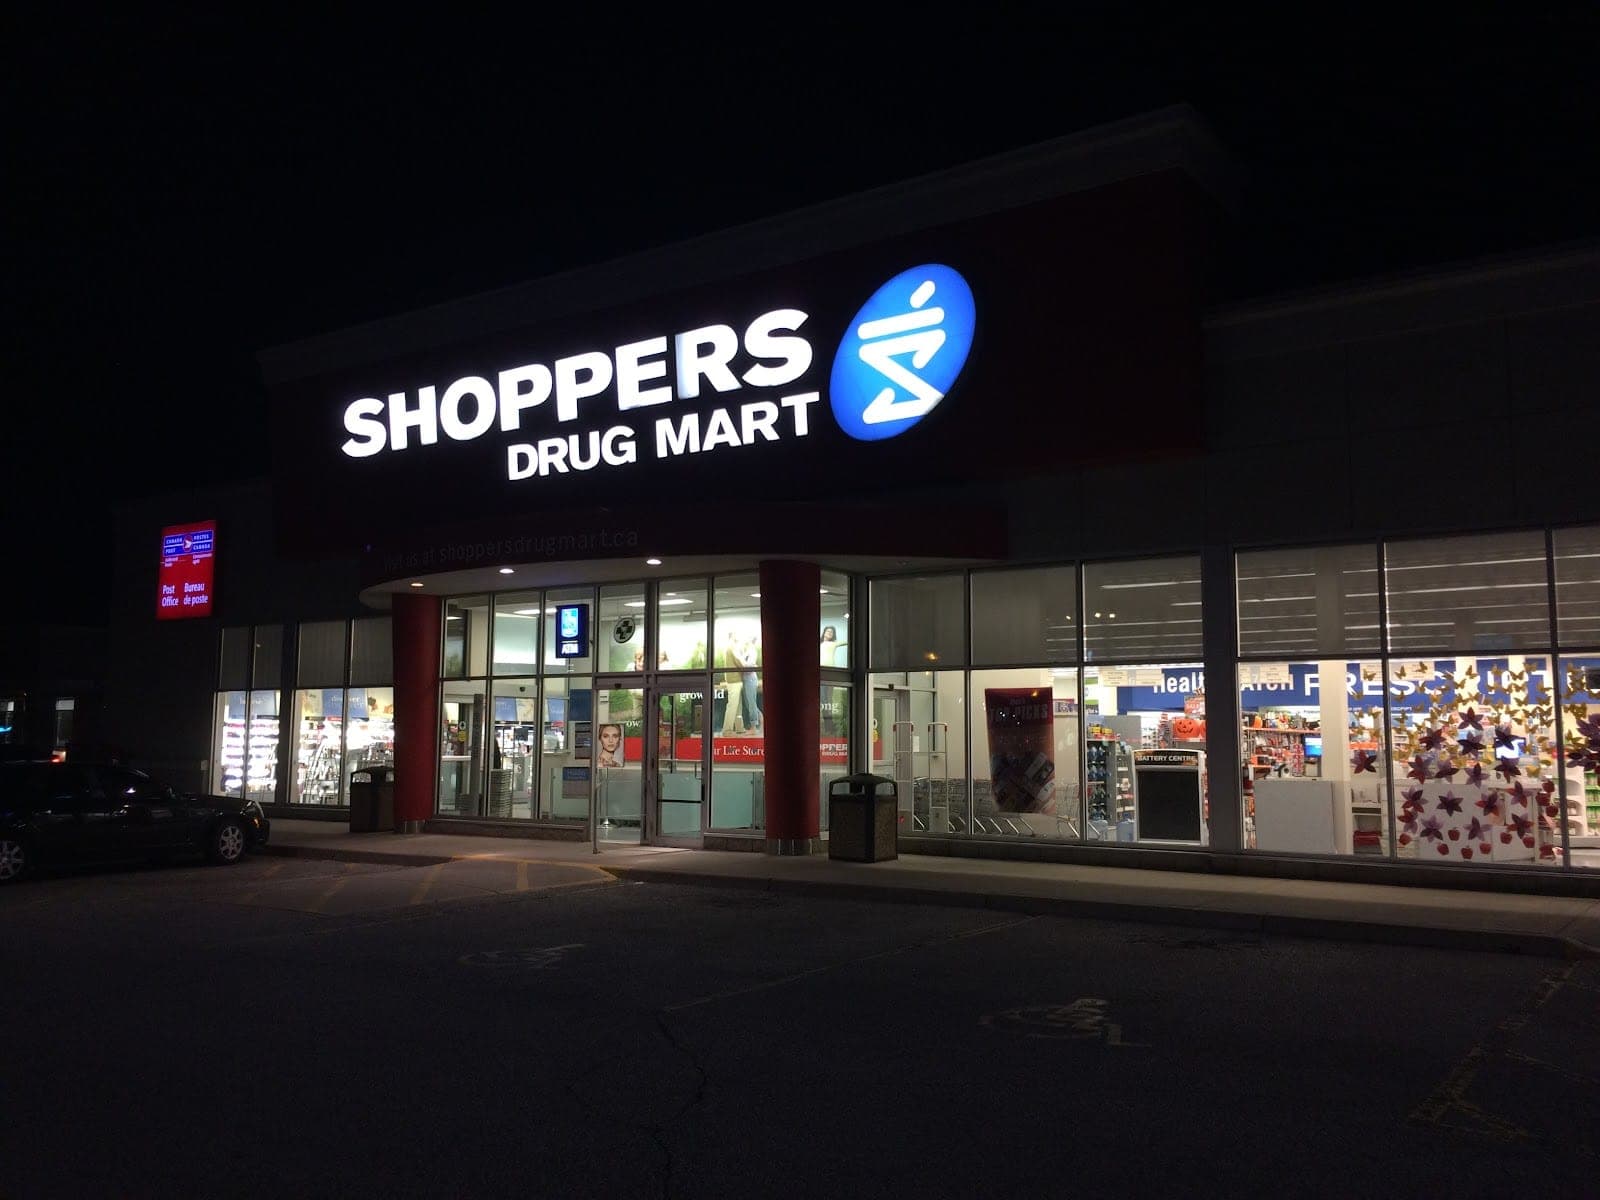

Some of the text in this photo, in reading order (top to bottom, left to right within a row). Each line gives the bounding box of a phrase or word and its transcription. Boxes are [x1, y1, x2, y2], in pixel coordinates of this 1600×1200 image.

[341, 308, 813, 458] SHOPPERS
[507, 391, 820, 481] DRUG MART
[162, 584, 176, 595] Post
[184, 582, 205, 593] Bureau
[161, 596, 179, 607] Office
[183, 594, 209, 607] de poste
[714, 688, 725, 699] ld
[723, 744, 741, 756] Life
